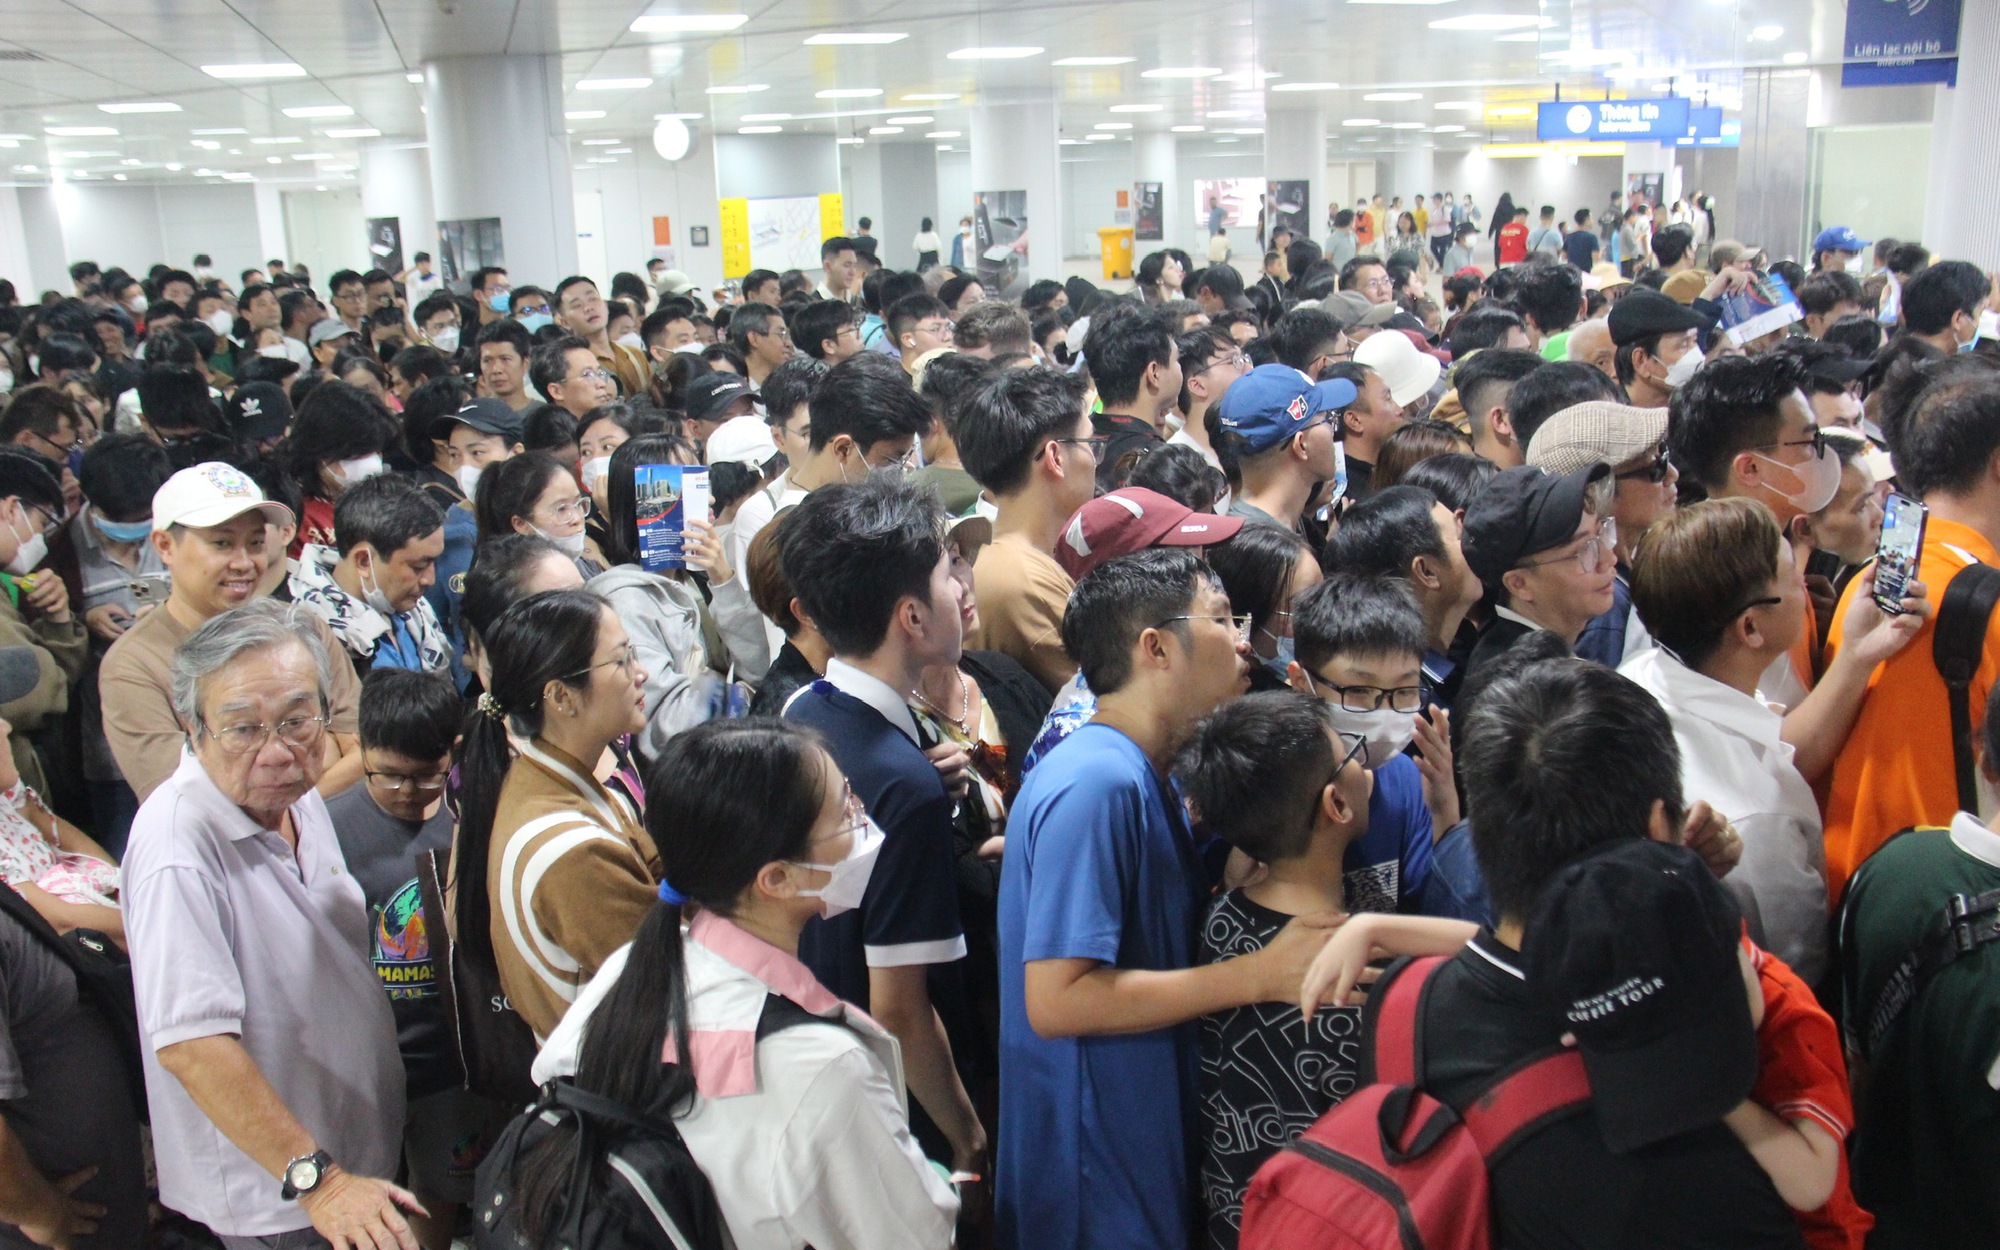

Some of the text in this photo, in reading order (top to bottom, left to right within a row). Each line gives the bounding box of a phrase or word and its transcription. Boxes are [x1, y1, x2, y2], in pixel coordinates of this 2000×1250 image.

[1854, 39, 1941, 57] Liên lạc nội bộ
[1600, 103, 1659, 122] Thông tin
[1566, 976, 1665, 1023] COFFEE TOUR
